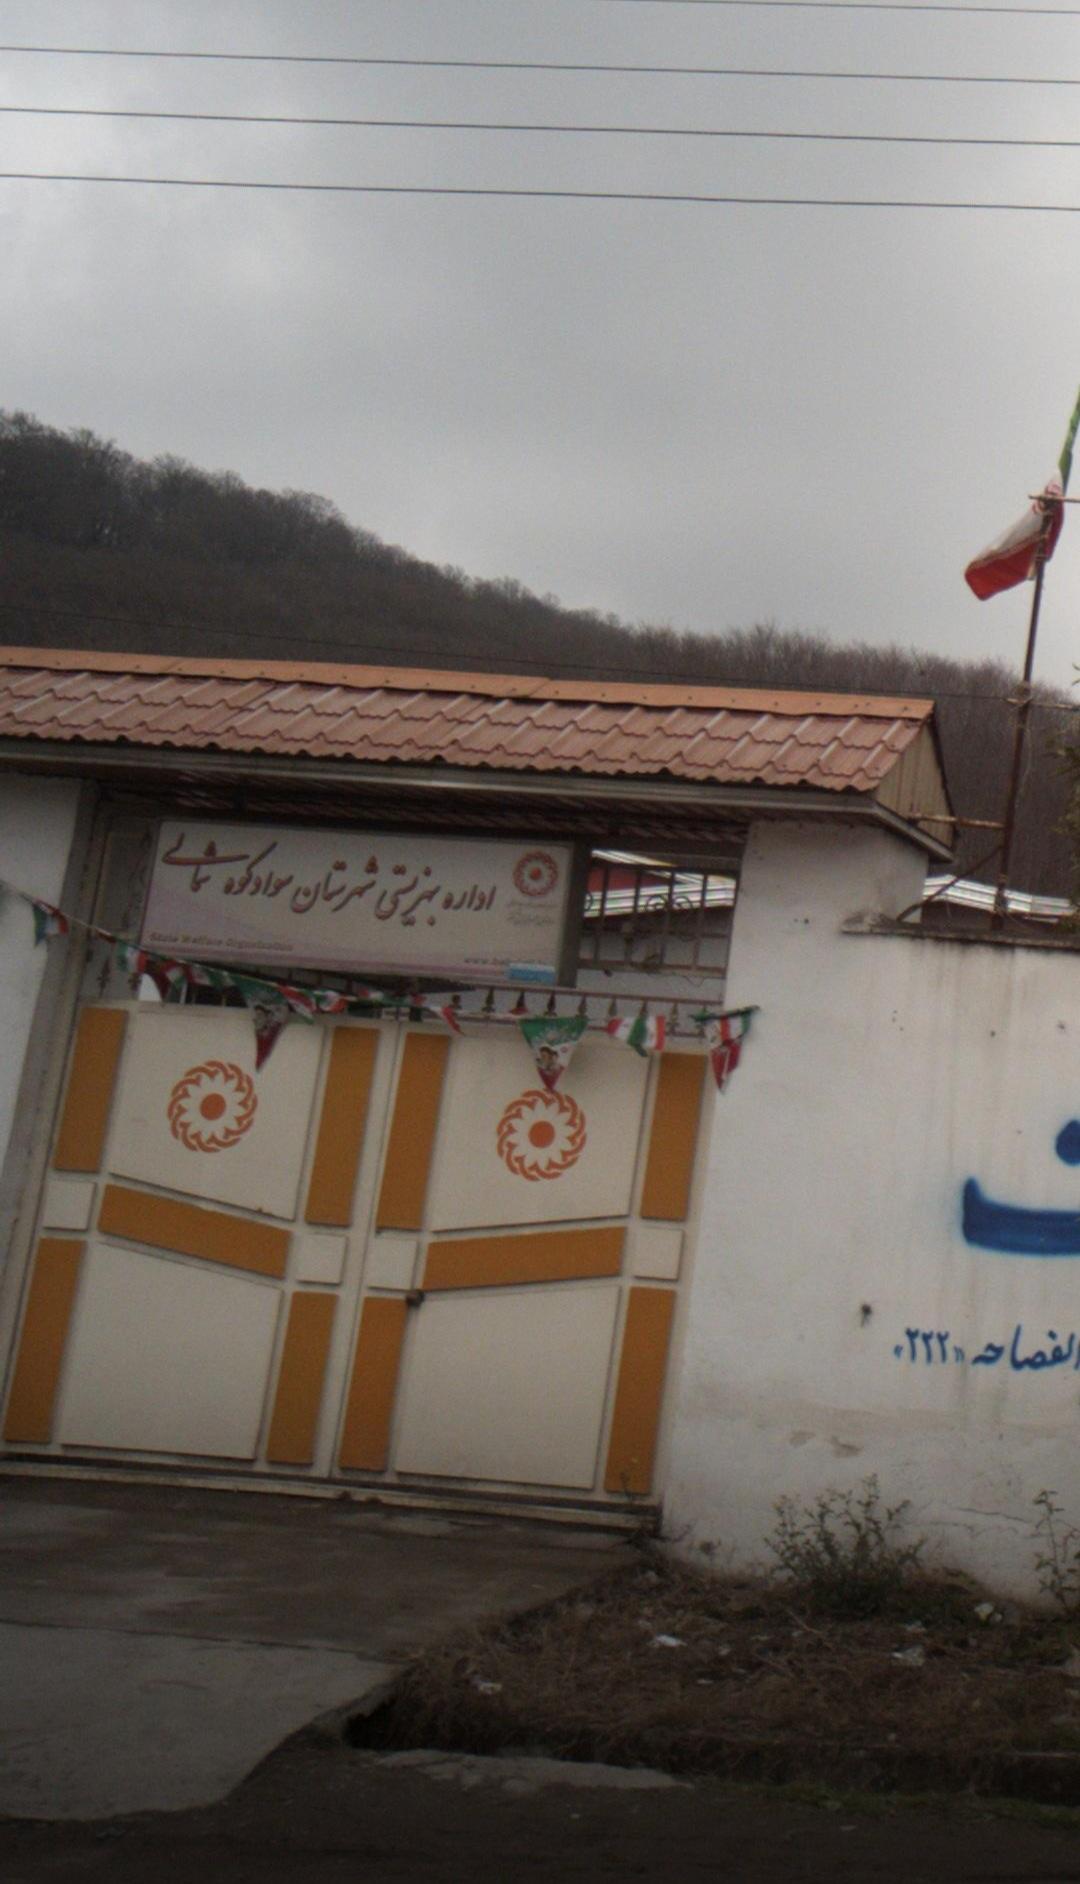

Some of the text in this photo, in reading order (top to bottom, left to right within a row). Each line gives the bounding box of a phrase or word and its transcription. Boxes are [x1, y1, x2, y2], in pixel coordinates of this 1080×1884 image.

[161, 832, 250, 893] شمالی
[223, 841, 294, 898] سوادکوه
[290, 856, 378, 914] شهرستان
[374, 864, 442, 926] بهزیستی
[442, 885, 496, 911] اداره
